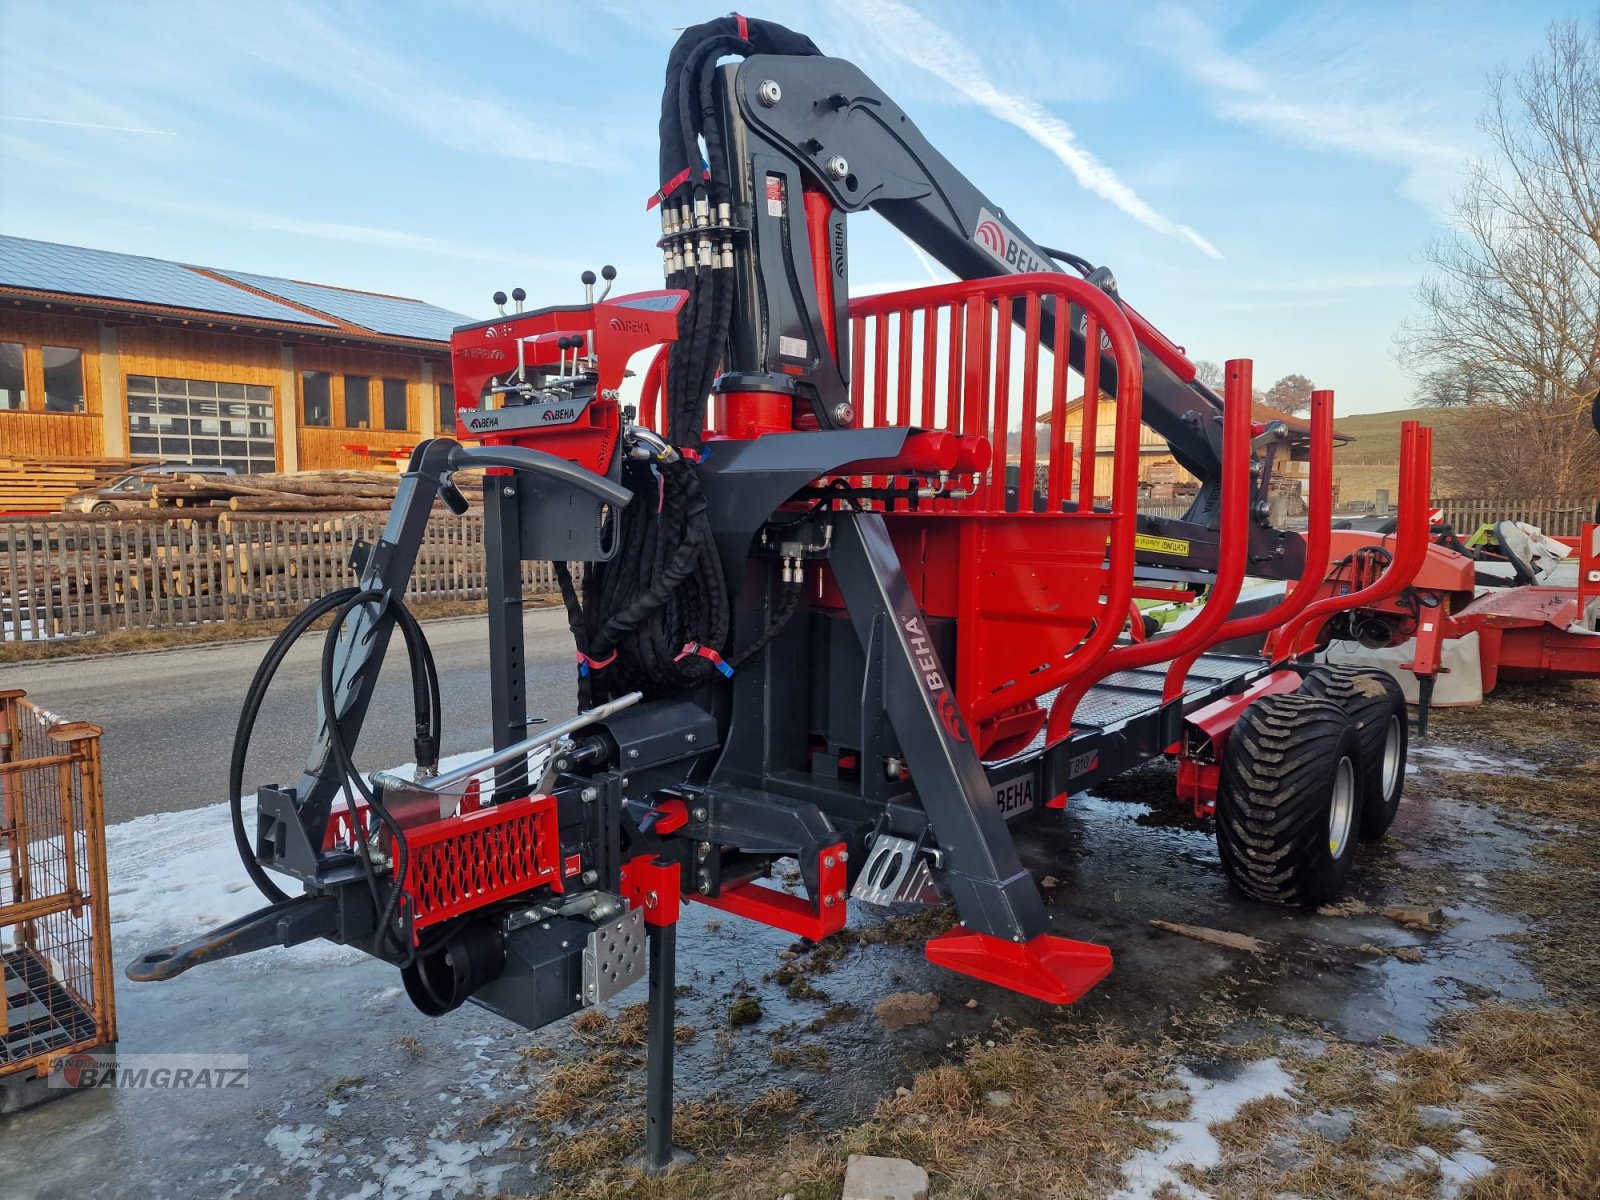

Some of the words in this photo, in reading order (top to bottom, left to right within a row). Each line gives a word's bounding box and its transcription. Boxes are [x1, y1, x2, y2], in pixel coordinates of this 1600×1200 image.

[835, 221, 843, 256] BEHA
[1005, 239, 1049, 273] BEH
[625, 319, 651, 335] BEHA
[481, 417, 499, 428] BEHA
[554, 408, 575, 420] BEHA
[905, 616, 945, 691] BEHA
[1074, 754, 1090, 774] 810
[997, 779, 1033, 814] BEHA
